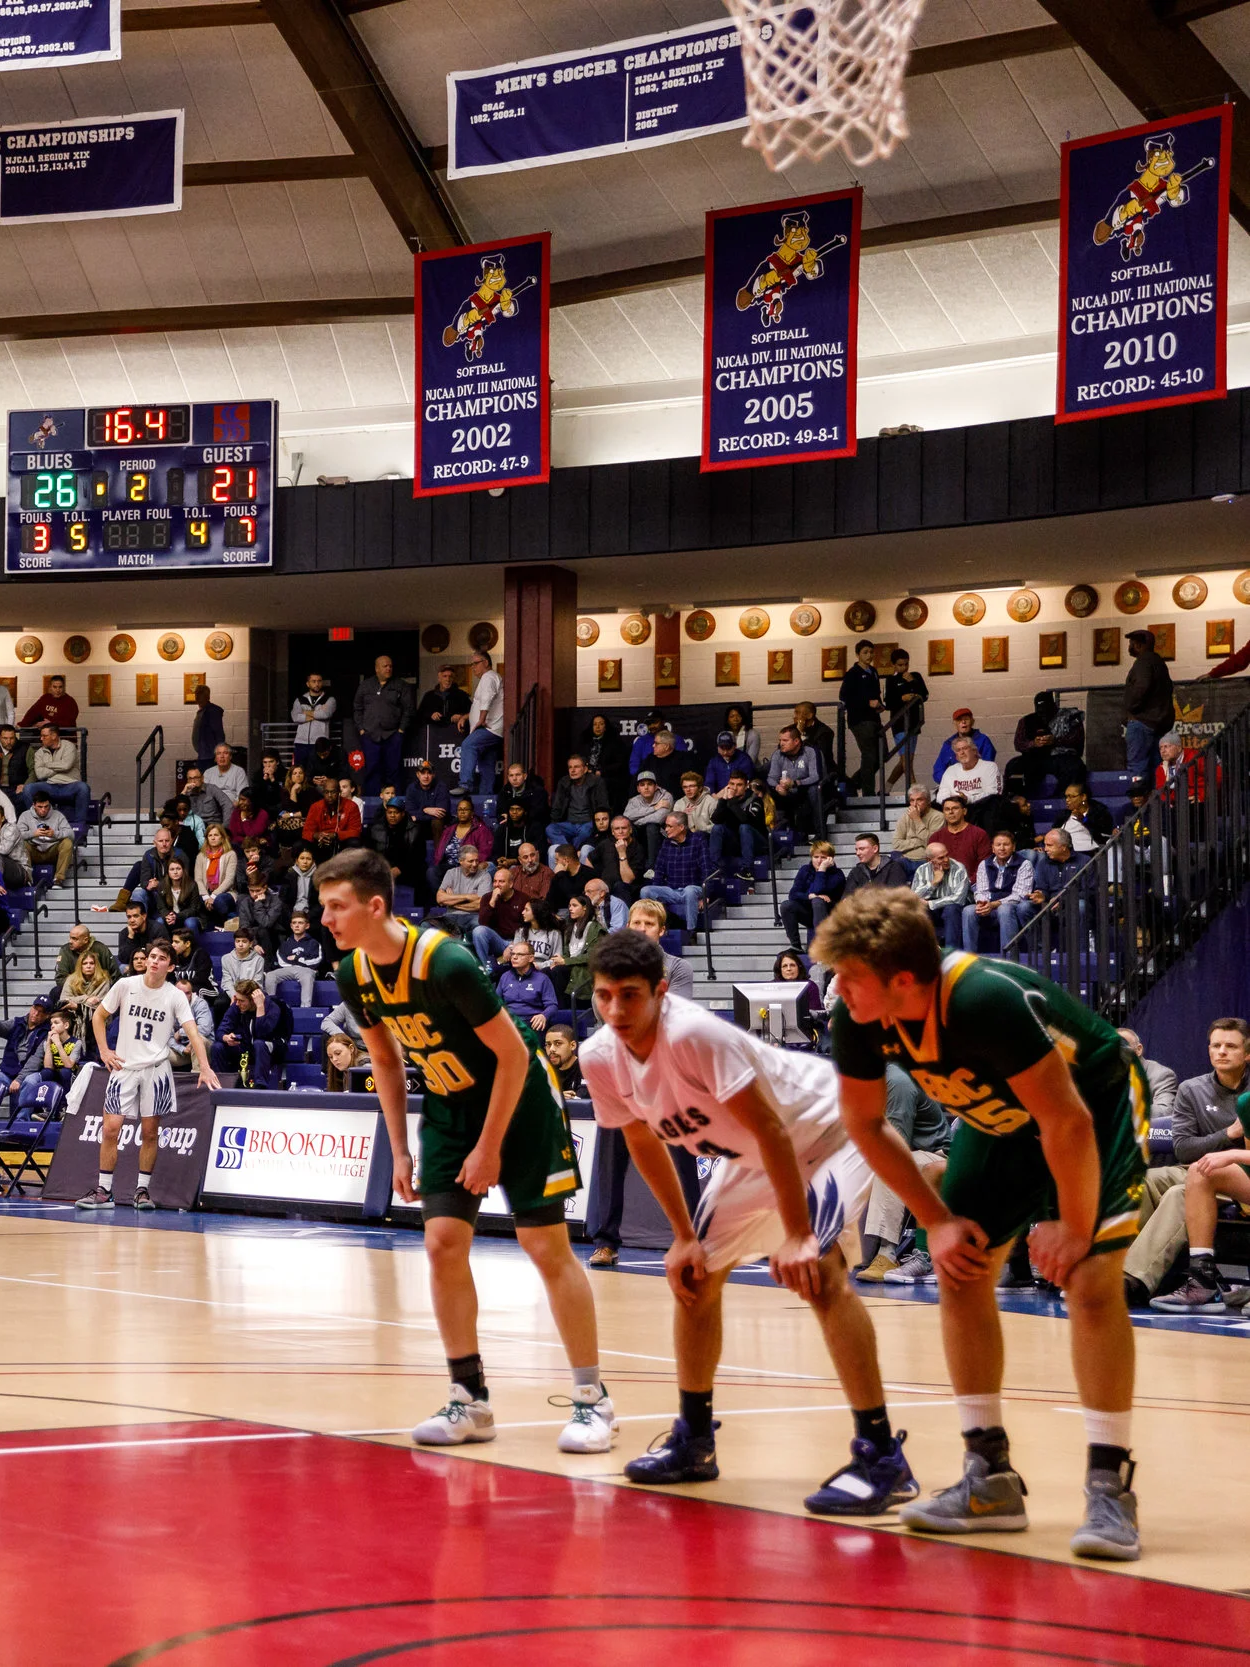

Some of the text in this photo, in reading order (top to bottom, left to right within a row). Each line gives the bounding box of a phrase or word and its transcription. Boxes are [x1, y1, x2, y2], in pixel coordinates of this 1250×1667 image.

[495, 24, 772, 95] MEN'S SOCCER CHAMPIONSHS
[635, 58, 725, 86] NJCAA REGION XIX
[662, 71, 713, 90] 2002,10,12
[493, 107, 525, 121] 2002,11
[636, 104, 678, 120] DISTRICT
[635, 118, 658, 132] 2002
[7, 126, 135, 150] CHAMPIONSHIPS
[5, 150, 90, 165] NJCAA REGION XIX
[5, 160, 87, 175] 2010,11,12,13,14,15
[1111, 261, 1173, 282] SOFTBALL
[1072, 274, 1213, 312] NJCAA DIV. III NATIONAL
[1070, 292, 1213, 335] CHAMPIONS
[751, 328, 809, 344] SOFTBALL
[716, 342, 844, 369] NJCAA DIV. III NATIONAL
[1103, 332, 1177, 370] 2010
[456, 362, 506, 379] SOFTBALL
[715, 359, 844, 392] CHAMPIONS
[425, 375, 537, 401] NJCAA DIV. III NATIONAL
[1077, 367, 1203, 401] RECORD: 45-10
[425, 391, 537, 422] CHAMPIONS
[744, 391, 814, 424] 2005
[104, 409, 166, 443] 16.4
[451, 423, 511, 453] 2002
[718, 427, 839, 452] RECORD: 49-8-1
[27, 454, 72, 469] BLUES
[120, 459, 156, 470] PERIOD
[203, 446, 252, 463] GUEST
[434, 455, 529, 479] RECORD: 47-9
[34, 473, 75, 508] 26
[130, 474, 147, 501] 2
[212, 467, 256, 502] 21
[20, 513, 52, 524] FOULS
[63, 511, 90, 522] T.O.L.
[102, 508, 172, 521] PLAYER FOUL
[183, 507, 211, 518] T.O.L.
[224, 505, 257, 517] FOULS
[34, 525, 48, 551] 3
[70, 524, 85, 550] 5
[190, 521, 206, 544] 4
[239, 517, 255, 543] 7
[19, 557, 52, 568] SCORE
[118, 554, 154, 566] MATCH
[222, 551, 257, 562] SCORE
[128, 1005, 166, 1022] EAGLES
[134, 1021, 153, 1042] 13
[409, 1050, 475, 1096] 30
[249, 1129, 371, 1161] BROOKDALE
